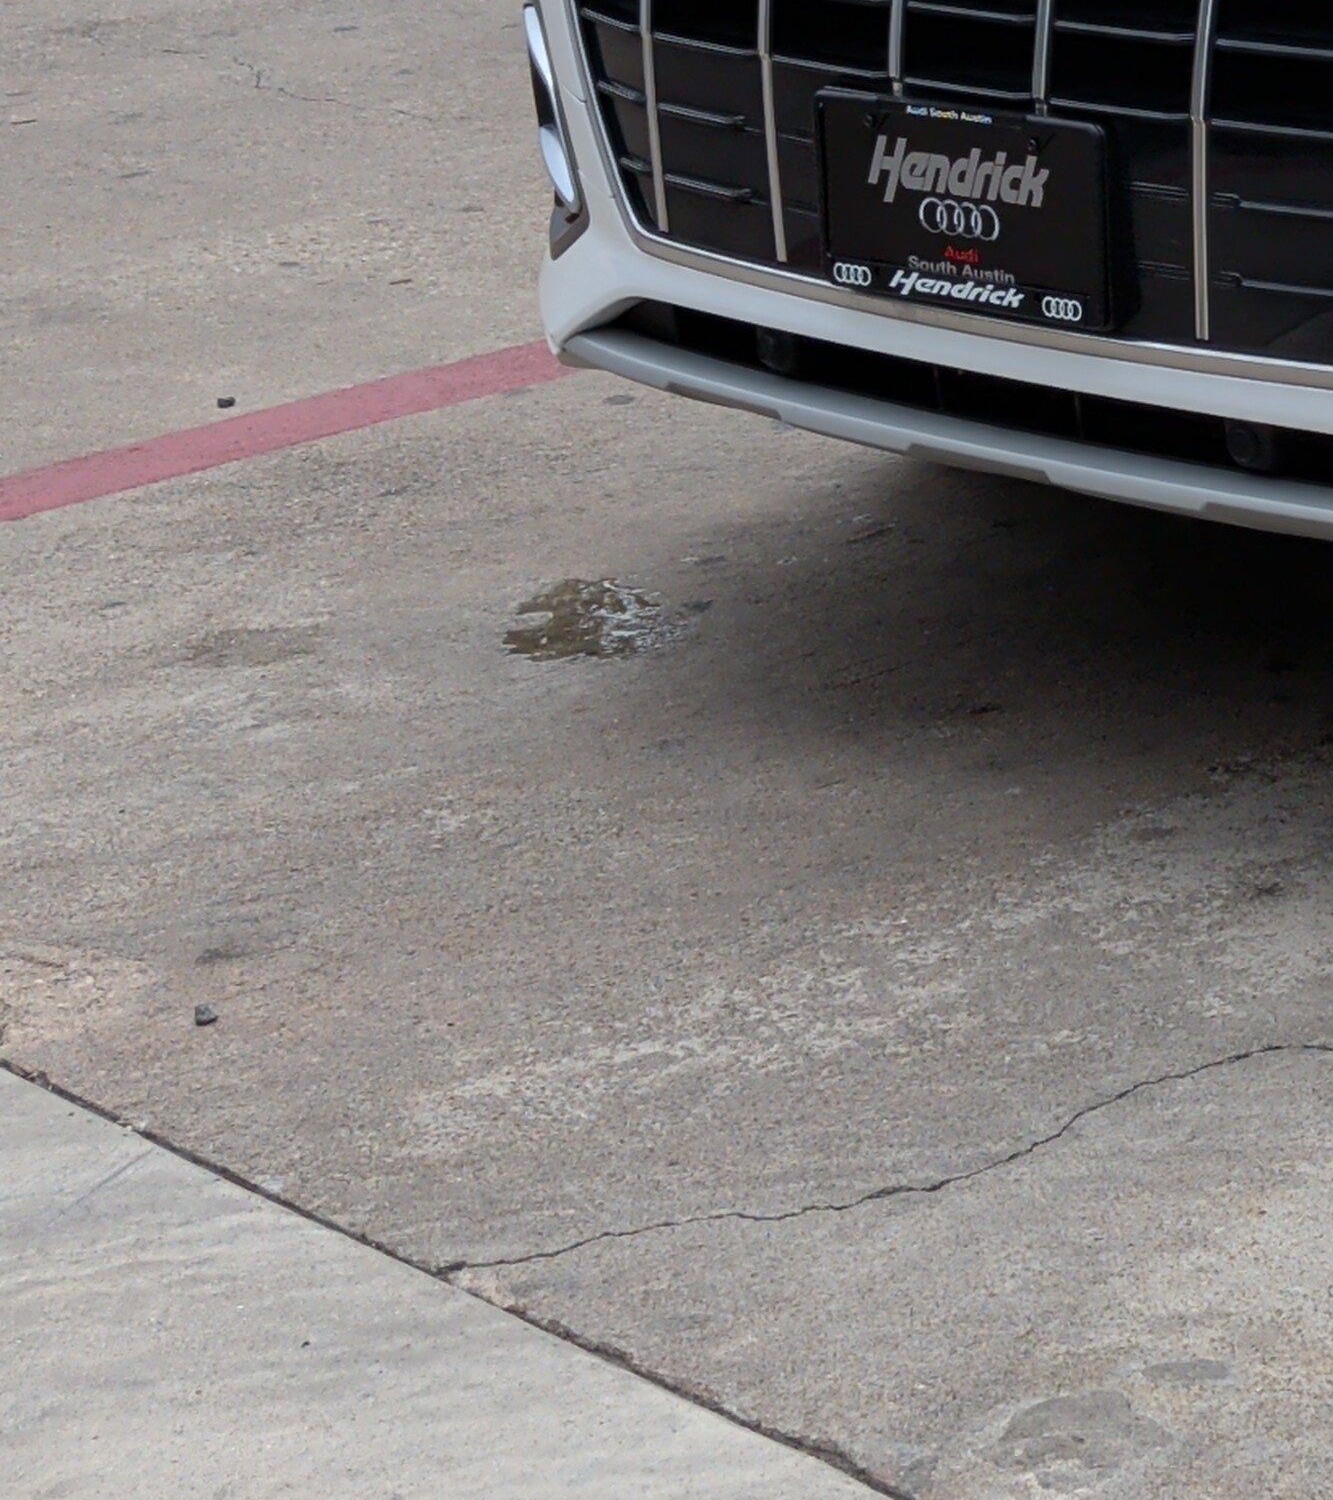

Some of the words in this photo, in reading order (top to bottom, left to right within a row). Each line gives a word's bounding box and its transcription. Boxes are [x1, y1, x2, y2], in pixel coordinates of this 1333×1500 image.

[906, 105, 928, 116] Audi
[929, 107, 958, 119] South
[960, 111, 992, 124] Austin
[867, 134, 1049, 208] Hendrick
[908, 254, 957, 276] South
[961, 264, 1016, 284] Austin
[944, 245, 980, 263] Audi
[889, 269, 1025, 309] Hendrick
